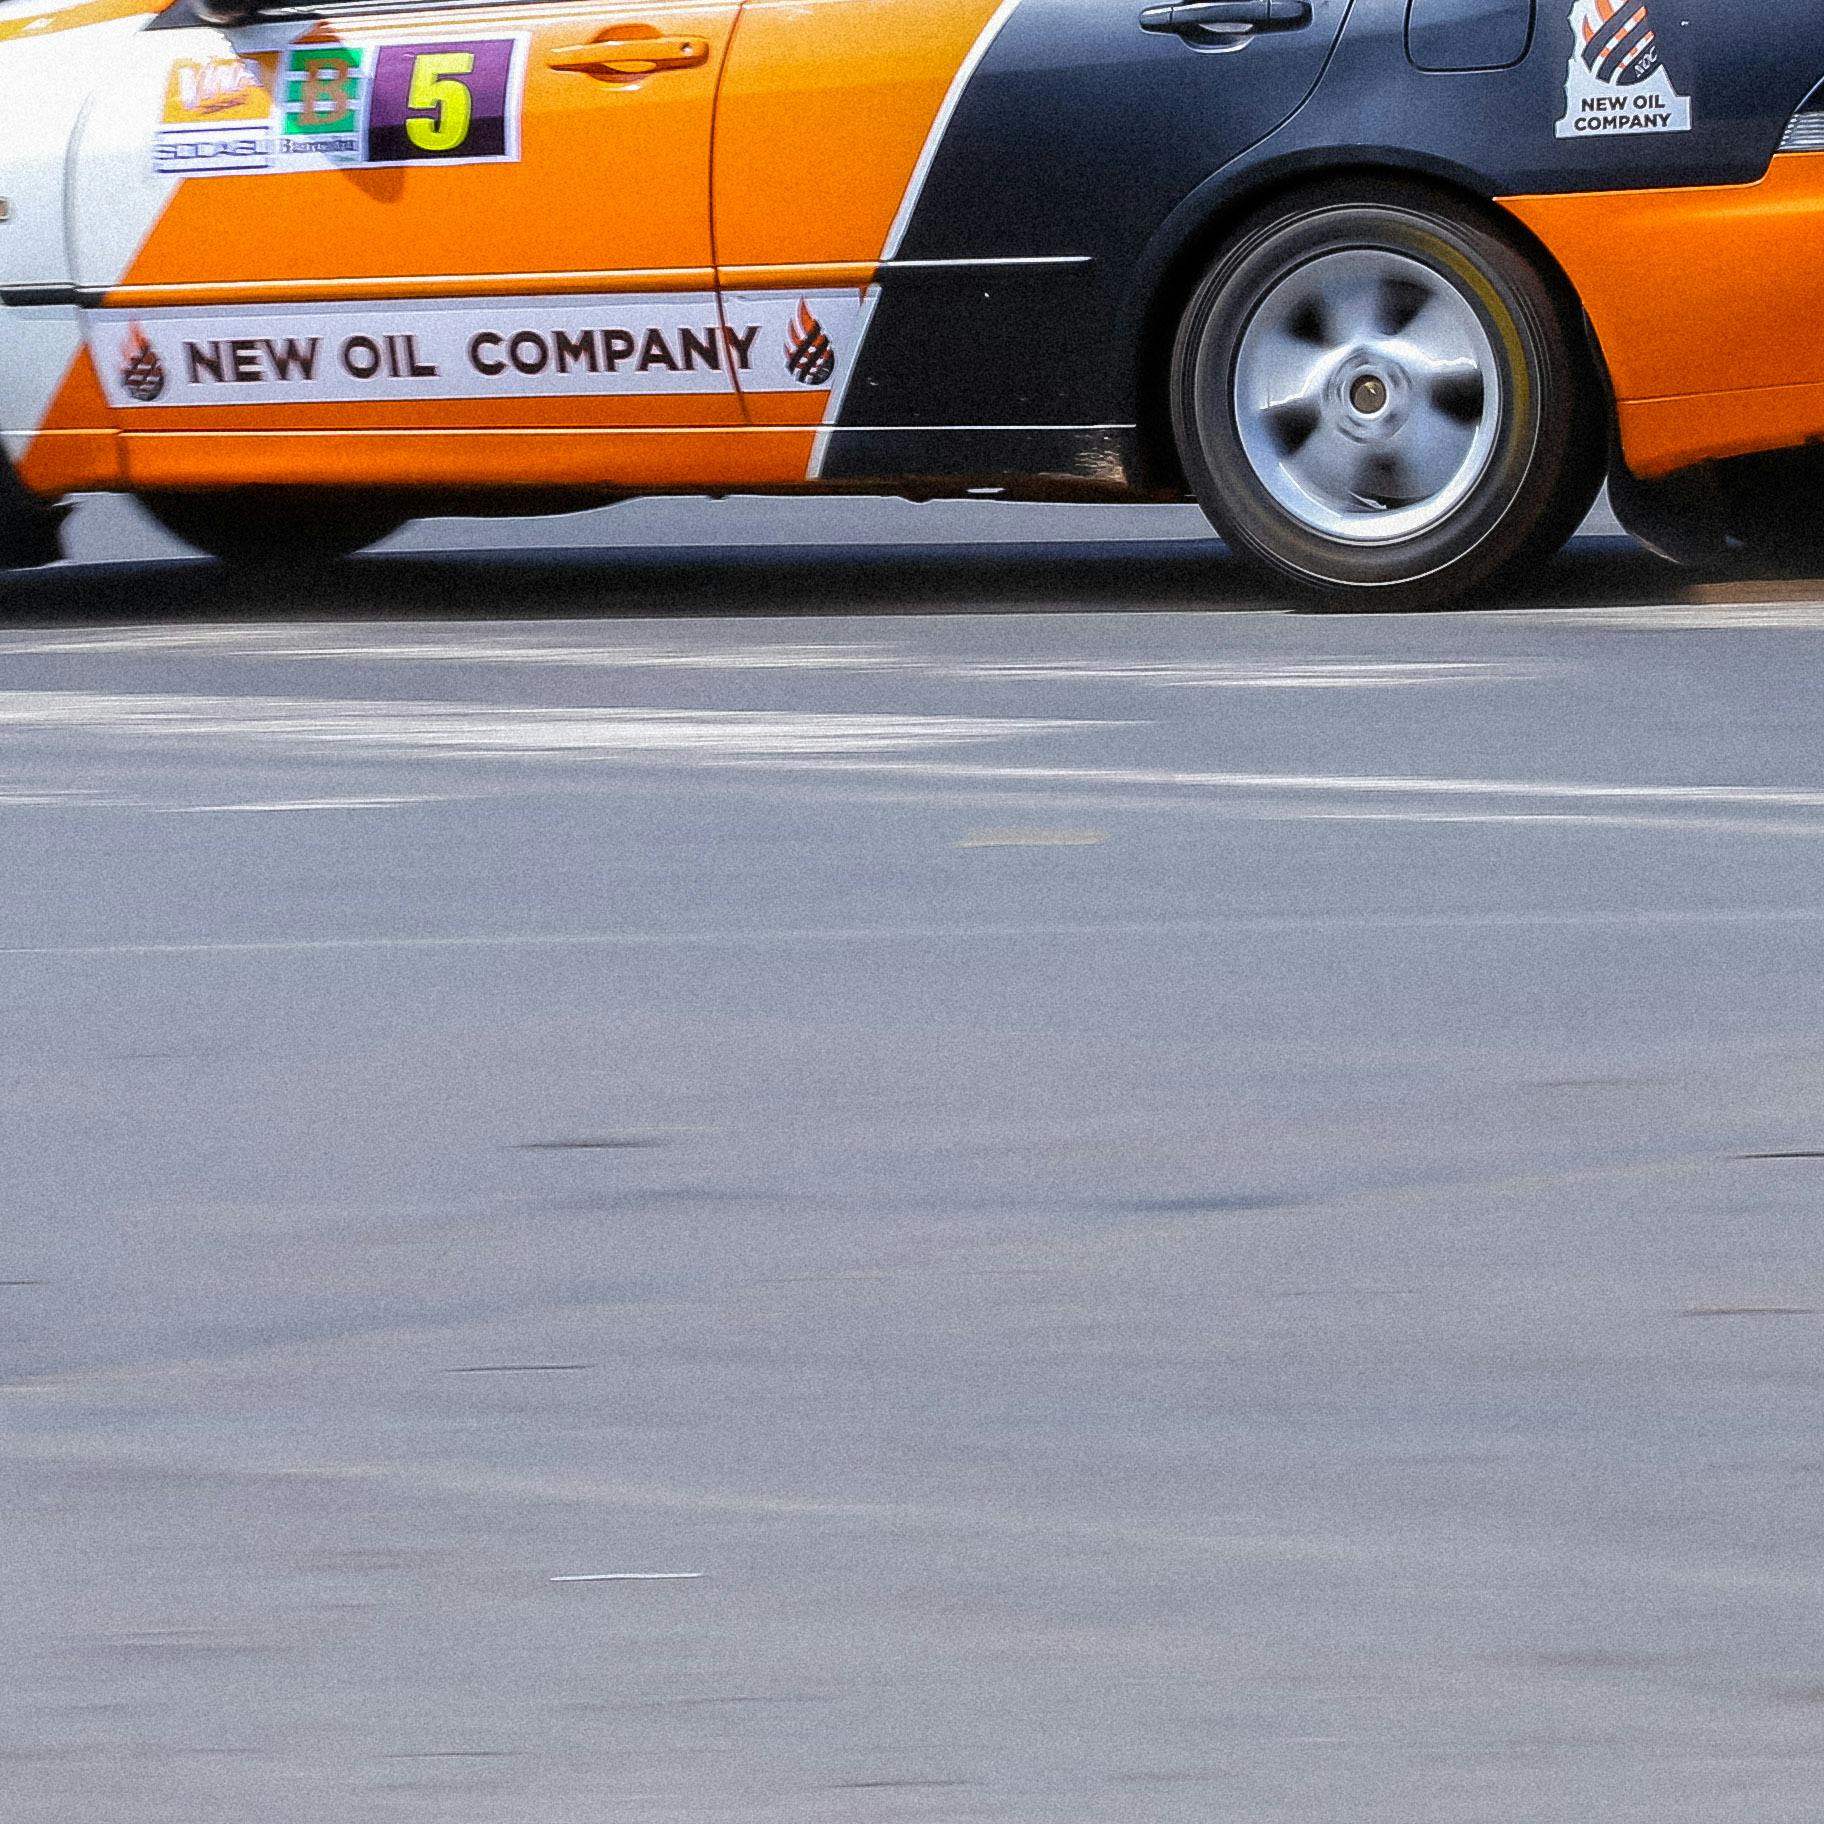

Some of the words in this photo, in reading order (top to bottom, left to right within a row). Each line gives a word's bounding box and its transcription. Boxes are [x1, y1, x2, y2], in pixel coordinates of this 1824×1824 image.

[406, 52, 474, 151] 5
[1581, 95, 1628, 112] NEW
[1633, 94, 1665, 110] OIL
[1574, 113, 1671, 131] COMPANY
[184, 337, 324, 383] NEW
[339, 334, 440, 379] OIL
[468, 325, 761, 376] COMPANY
